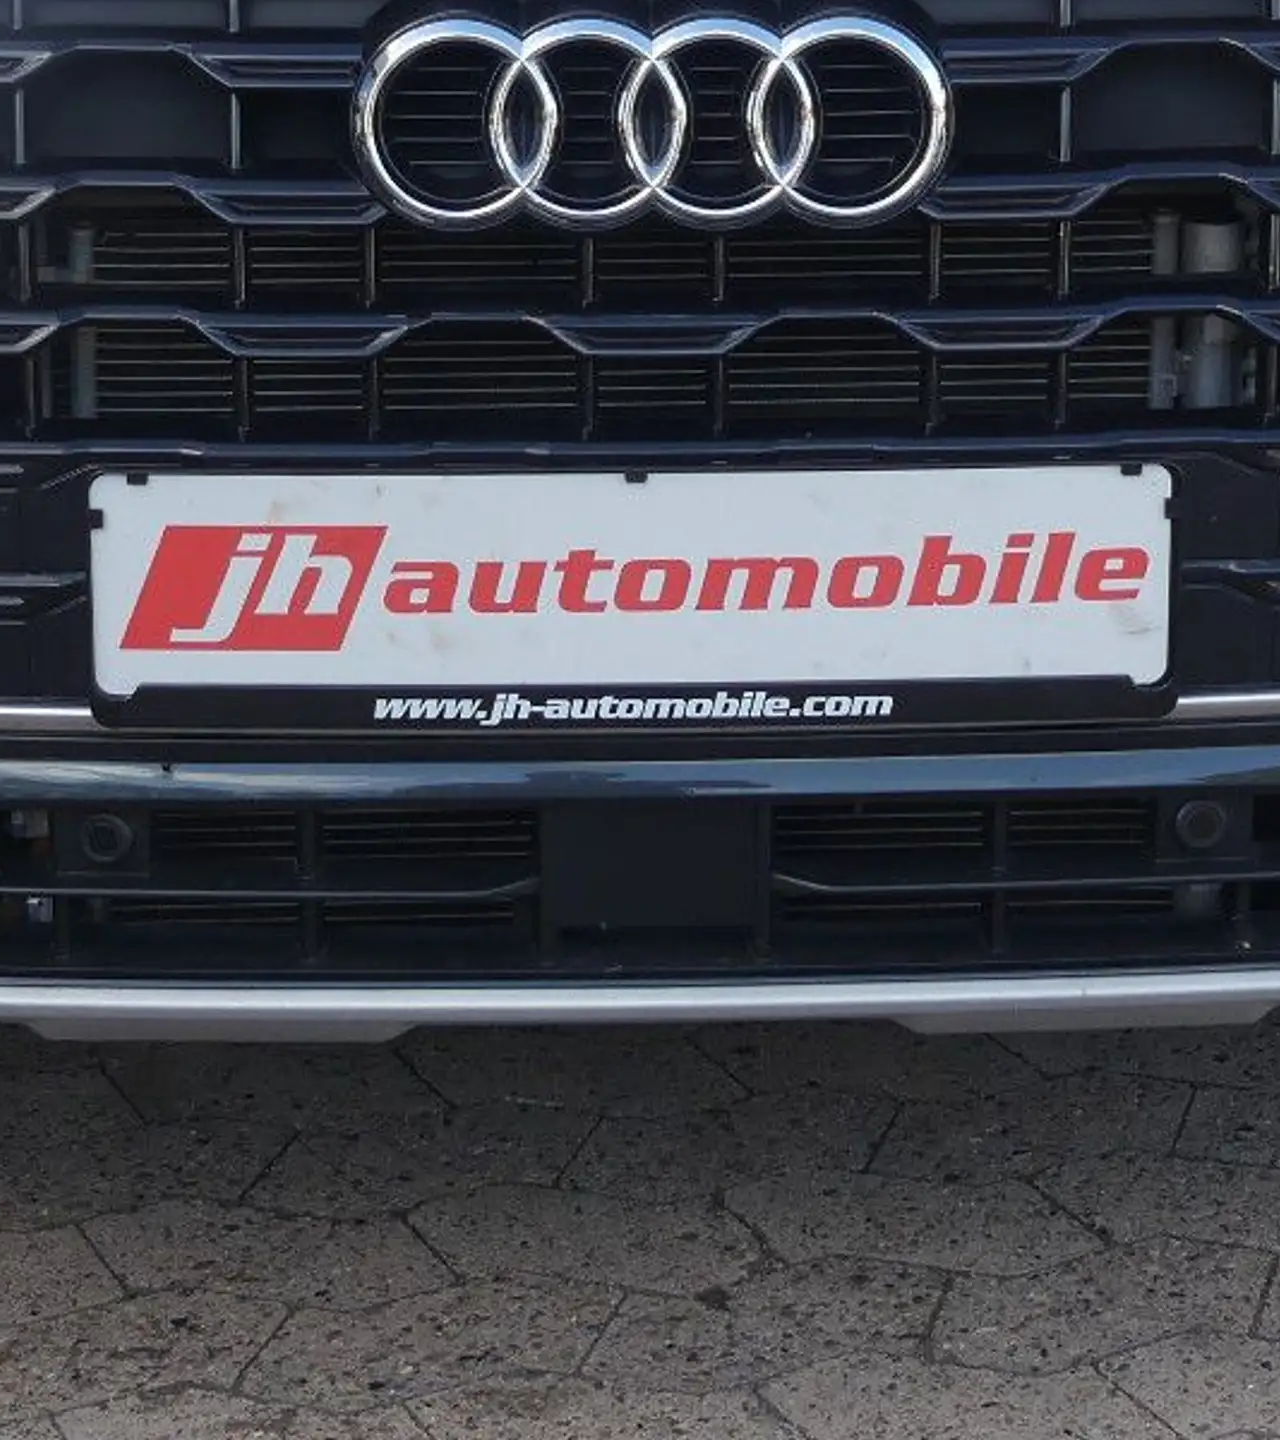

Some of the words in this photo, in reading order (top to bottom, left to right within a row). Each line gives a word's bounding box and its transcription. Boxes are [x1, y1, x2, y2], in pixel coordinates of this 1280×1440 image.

[169, 533, 353, 642] jh
[383, 532, 1149, 614] automobile
[373, 692, 894, 726] www.jh-automobile.com
